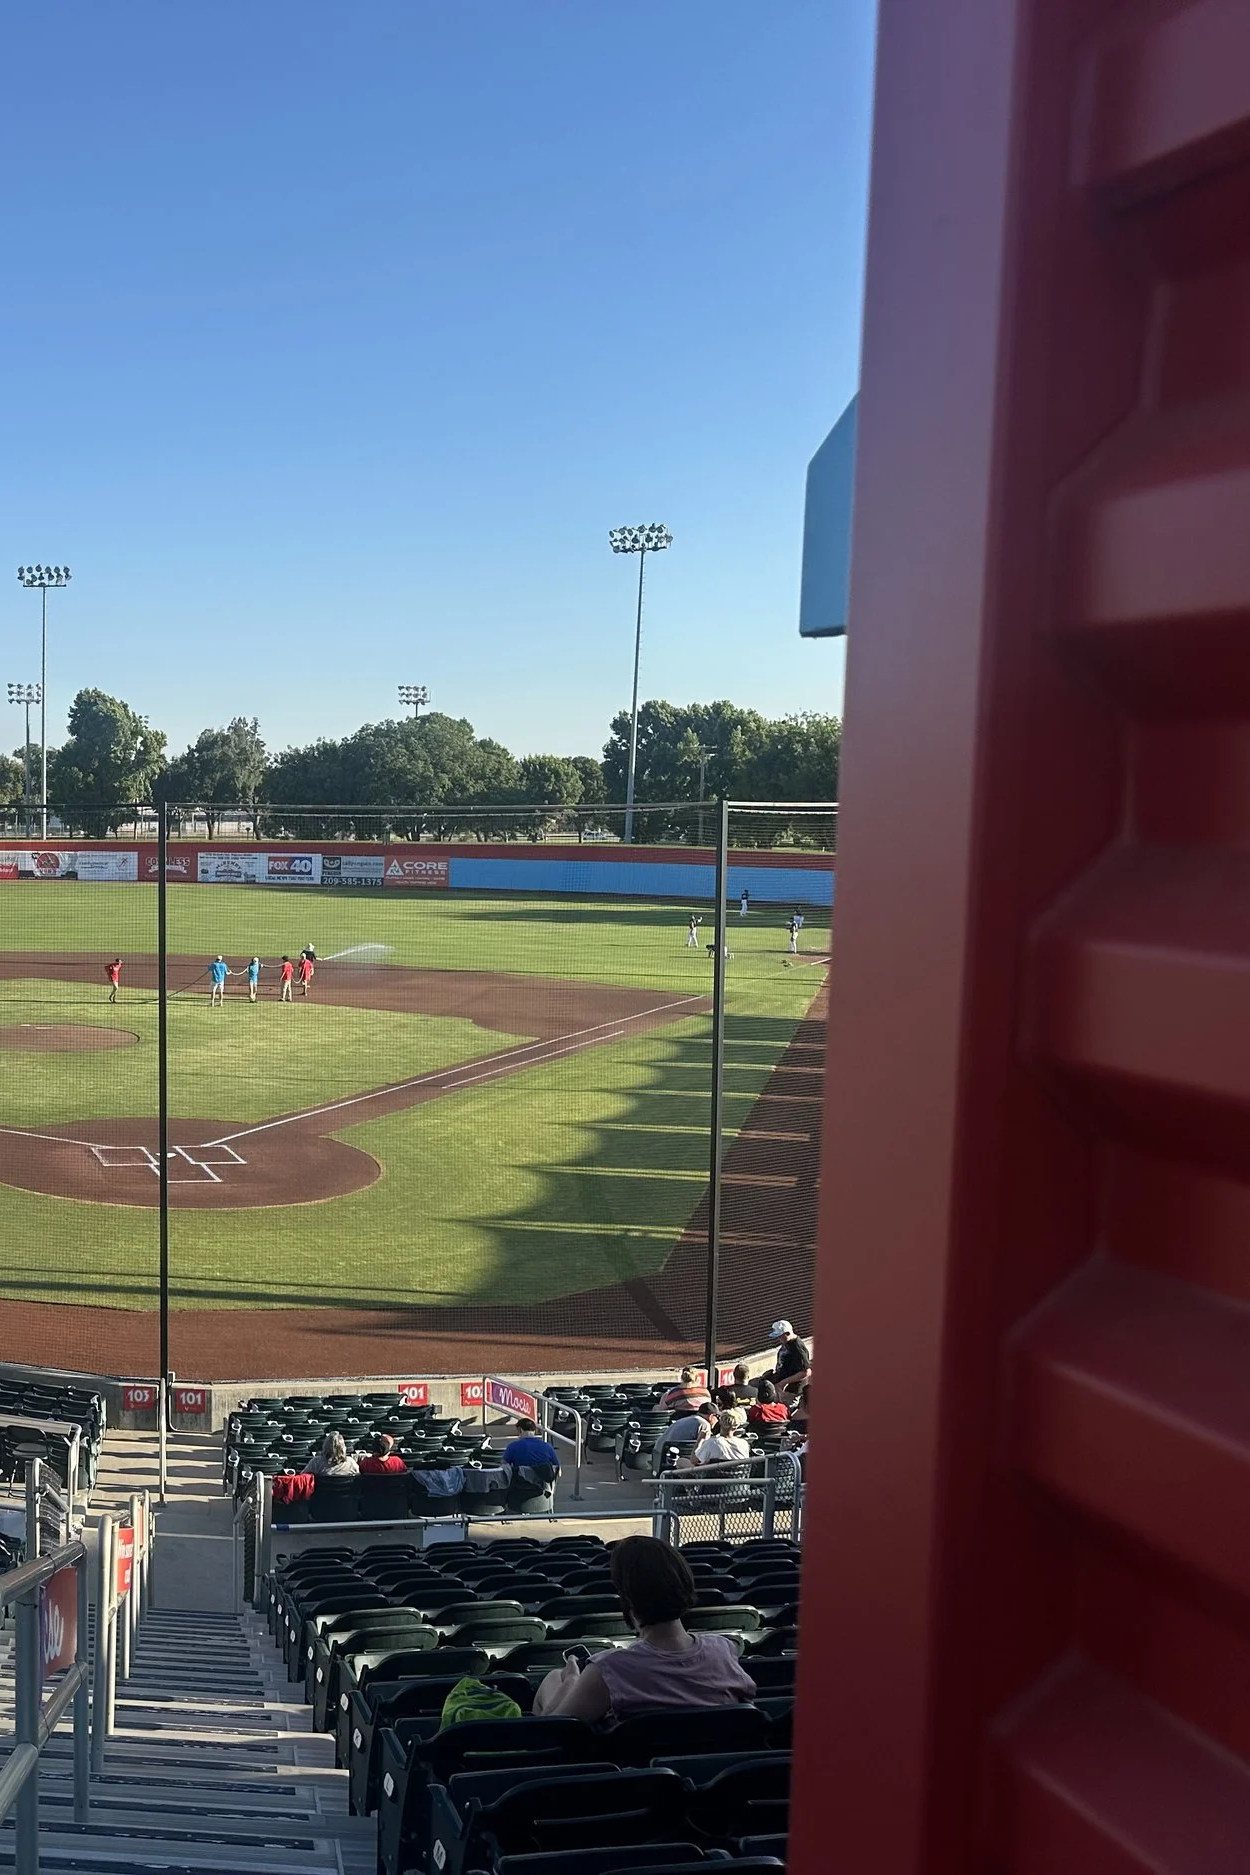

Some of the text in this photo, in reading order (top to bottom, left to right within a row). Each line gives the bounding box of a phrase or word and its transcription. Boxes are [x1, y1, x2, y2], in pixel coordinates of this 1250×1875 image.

[269, 860, 312, 872] FOX 40
[403, 862, 448, 870] CORE
[323, 877, 382, 886] 209-585-1375
[127, 1389, 150, 1402] 103
[180, 1391, 203, 1405] 101
[401, 1386, 424, 1401] 101
